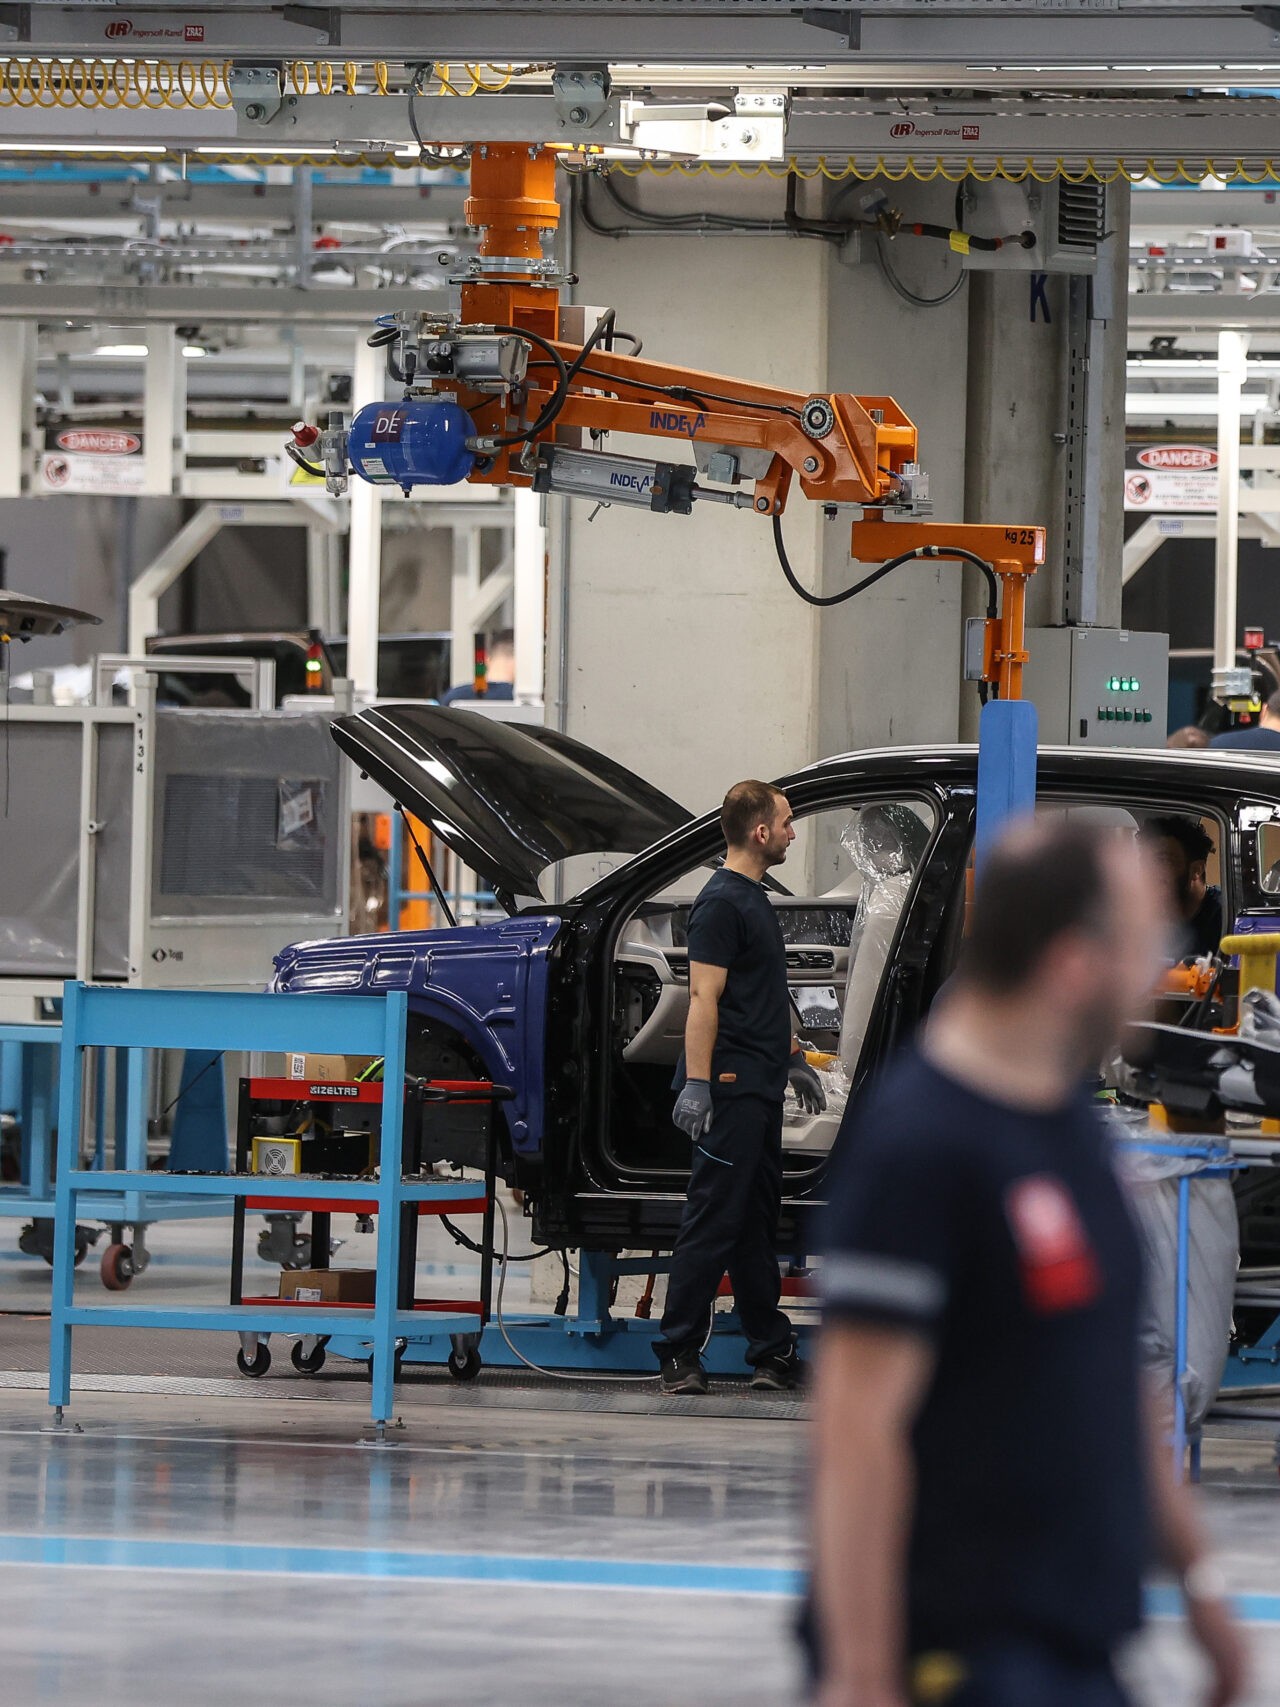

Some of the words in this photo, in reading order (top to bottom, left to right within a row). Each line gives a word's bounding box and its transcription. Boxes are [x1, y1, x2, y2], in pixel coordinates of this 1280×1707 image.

[107, 21, 130, 37] IR
[133, 29, 163, 38] Ingersoll
[165, 29, 183, 37] Rand
[186, 27, 203, 37] ZRA2
[892, 123, 913, 137] IR
[915, 129, 942, 137] Ingersoll
[963, 127, 978, 136] ZRA2
[1030, 272, 1051, 324] K
[376, 417, 401, 434] DE
[650, 411, 706, 437] INDEVA
[66, 434, 126, 452] DANGER
[1148, 451, 1212, 466] DANGER
[610, 473, 650, 493] INDEVA
[1005, 529, 1018, 544] kg
[1020, 530, 1035, 546] 25
